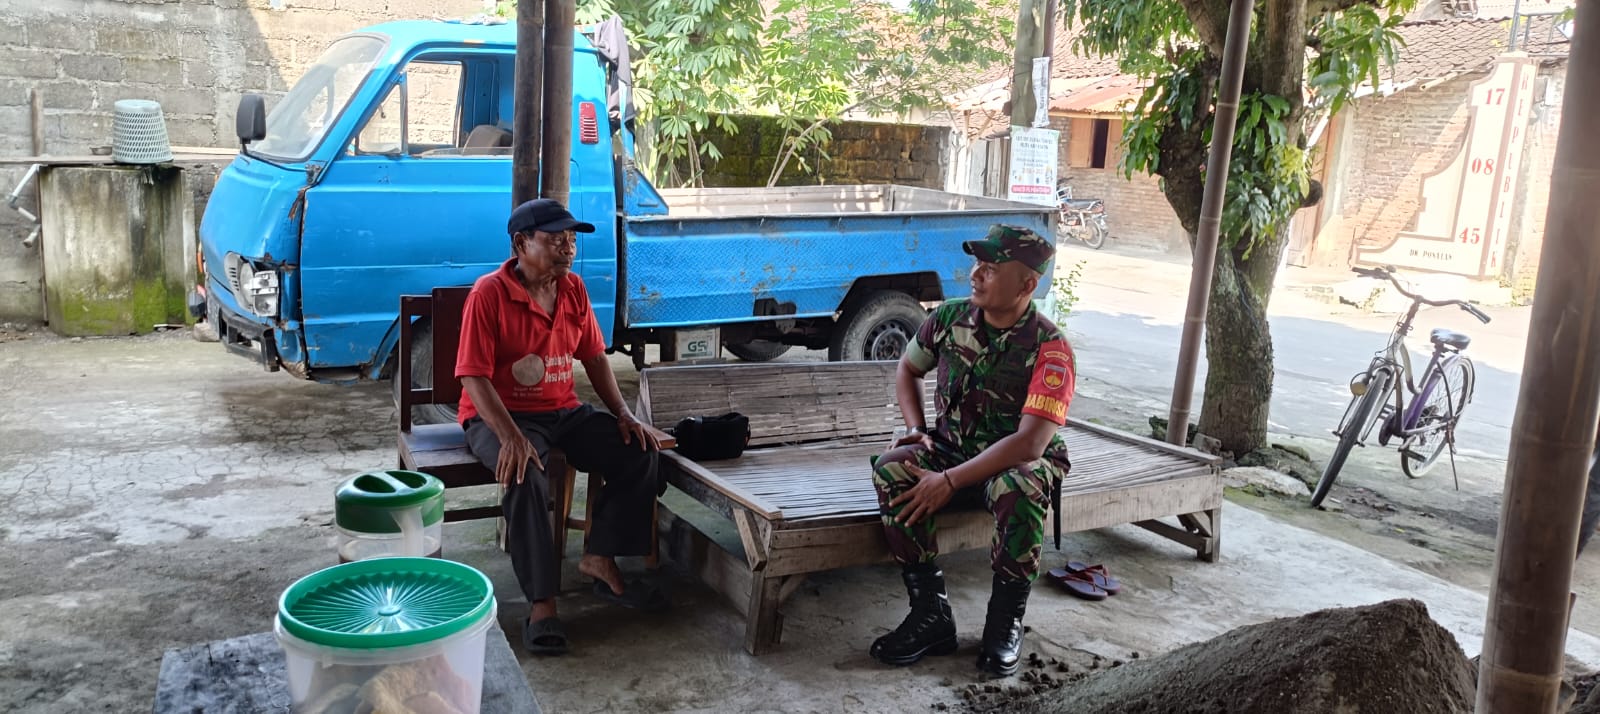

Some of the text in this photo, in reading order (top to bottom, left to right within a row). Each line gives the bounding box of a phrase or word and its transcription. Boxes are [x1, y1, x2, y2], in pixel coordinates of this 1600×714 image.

[1485, 88, 1505, 105] 17
[1471, 158, 1494, 175] 08
[1458, 227, 1480, 245] 45
[687, 340, 707, 352] GS
